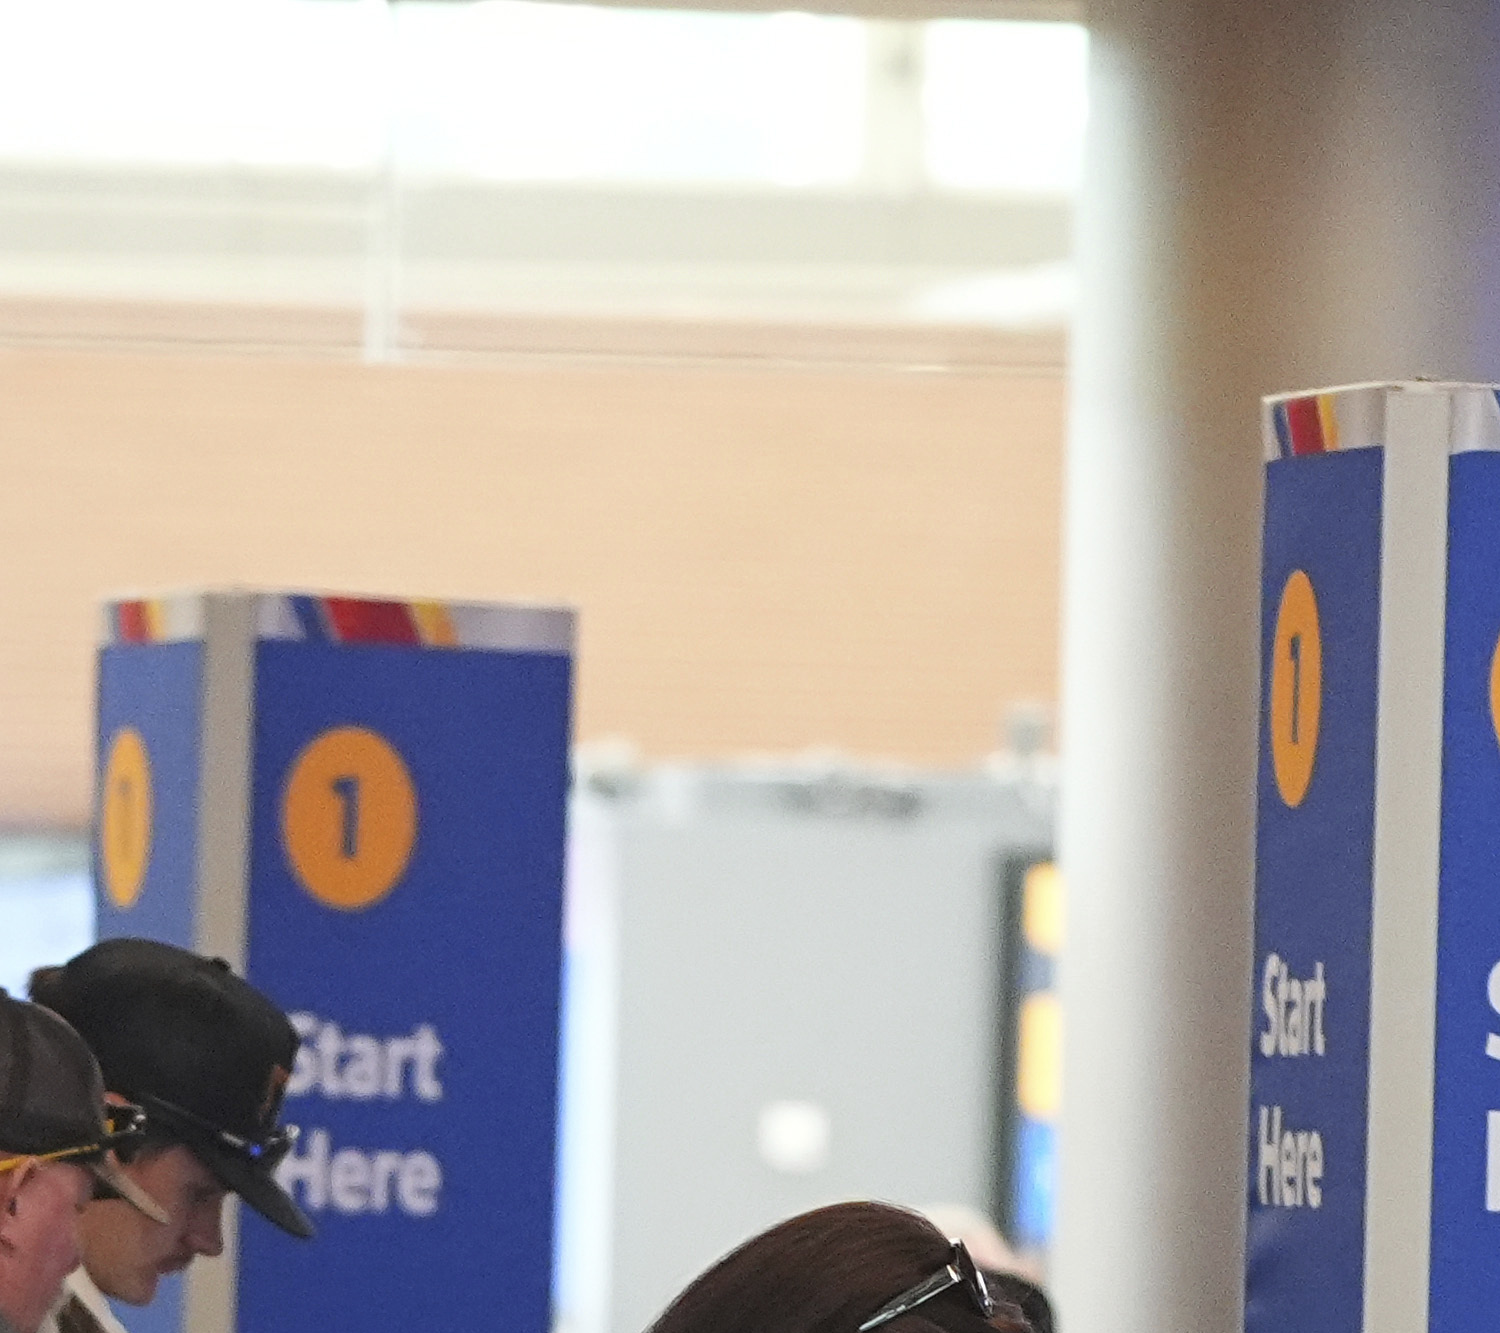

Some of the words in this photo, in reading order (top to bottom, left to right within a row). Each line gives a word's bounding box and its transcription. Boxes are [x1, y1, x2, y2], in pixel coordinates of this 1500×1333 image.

[1288, 634, 1302, 744] 1
[331, 773, 359, 861] 1
[1261, 952, 1326, 1057] Start
[285, 1010, 443, 1101] Start
[273, 1128, 443, 1216] Here
[1258, 1104, 1323, 1208] Here
